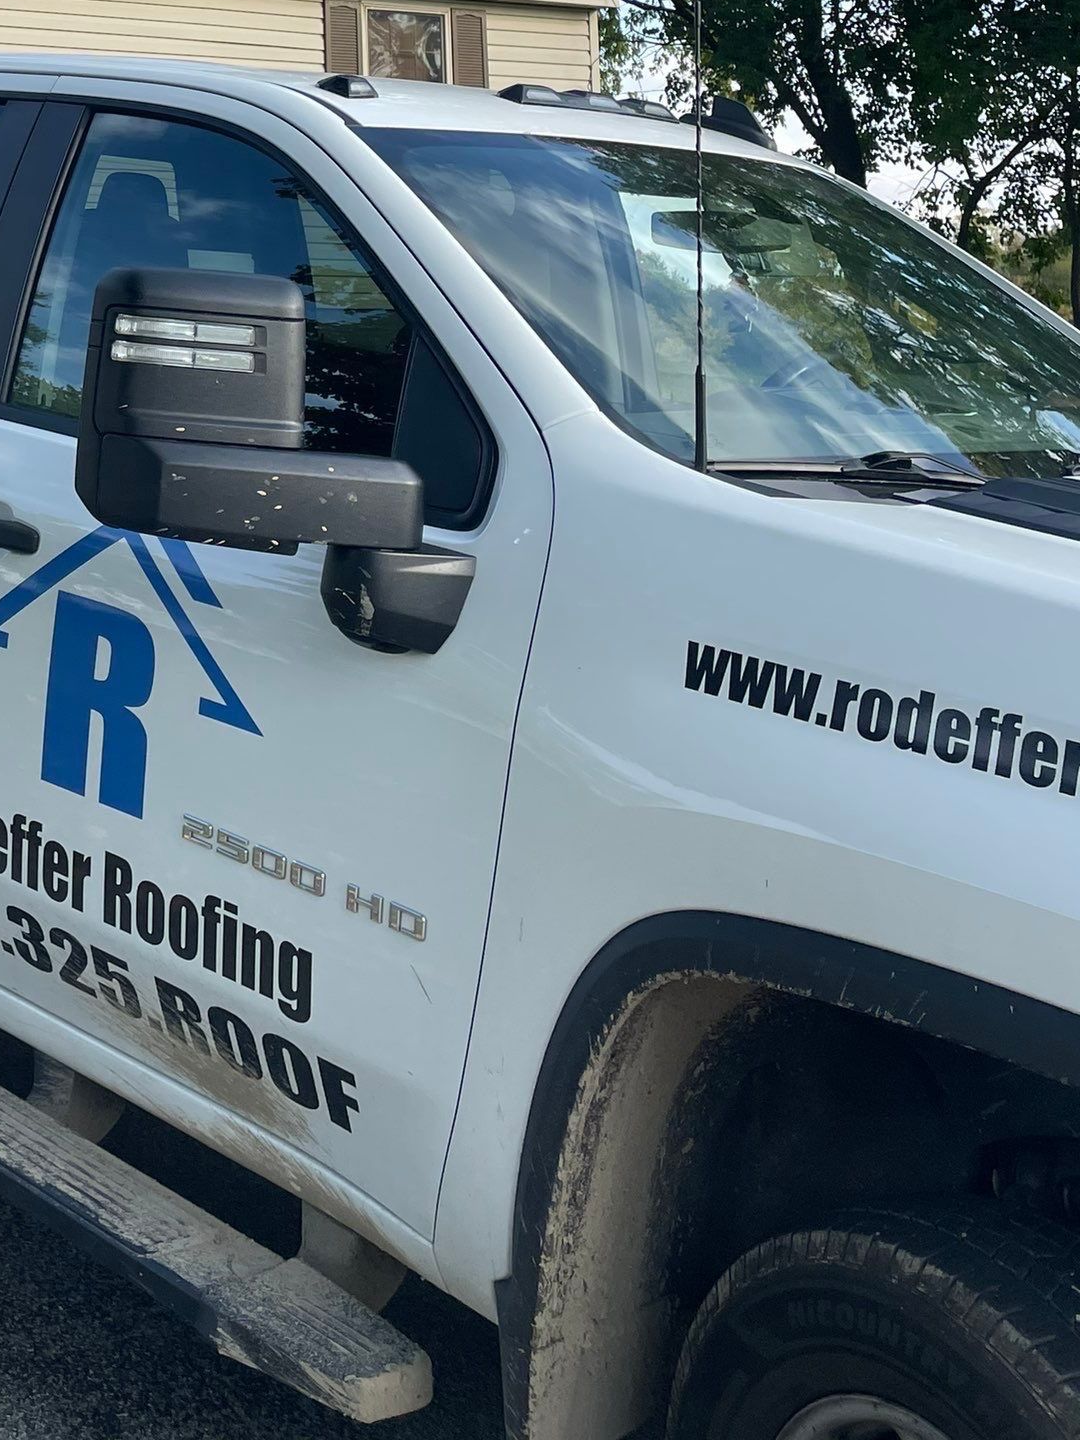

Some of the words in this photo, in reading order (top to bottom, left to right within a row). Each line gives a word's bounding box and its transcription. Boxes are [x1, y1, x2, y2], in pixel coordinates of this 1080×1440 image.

[41, 590, 156, 820] R
[103, 850, 313, 1023] Roofing
[181, 813, 326, 897] 2500
[346, 882, 427, 941] HD
